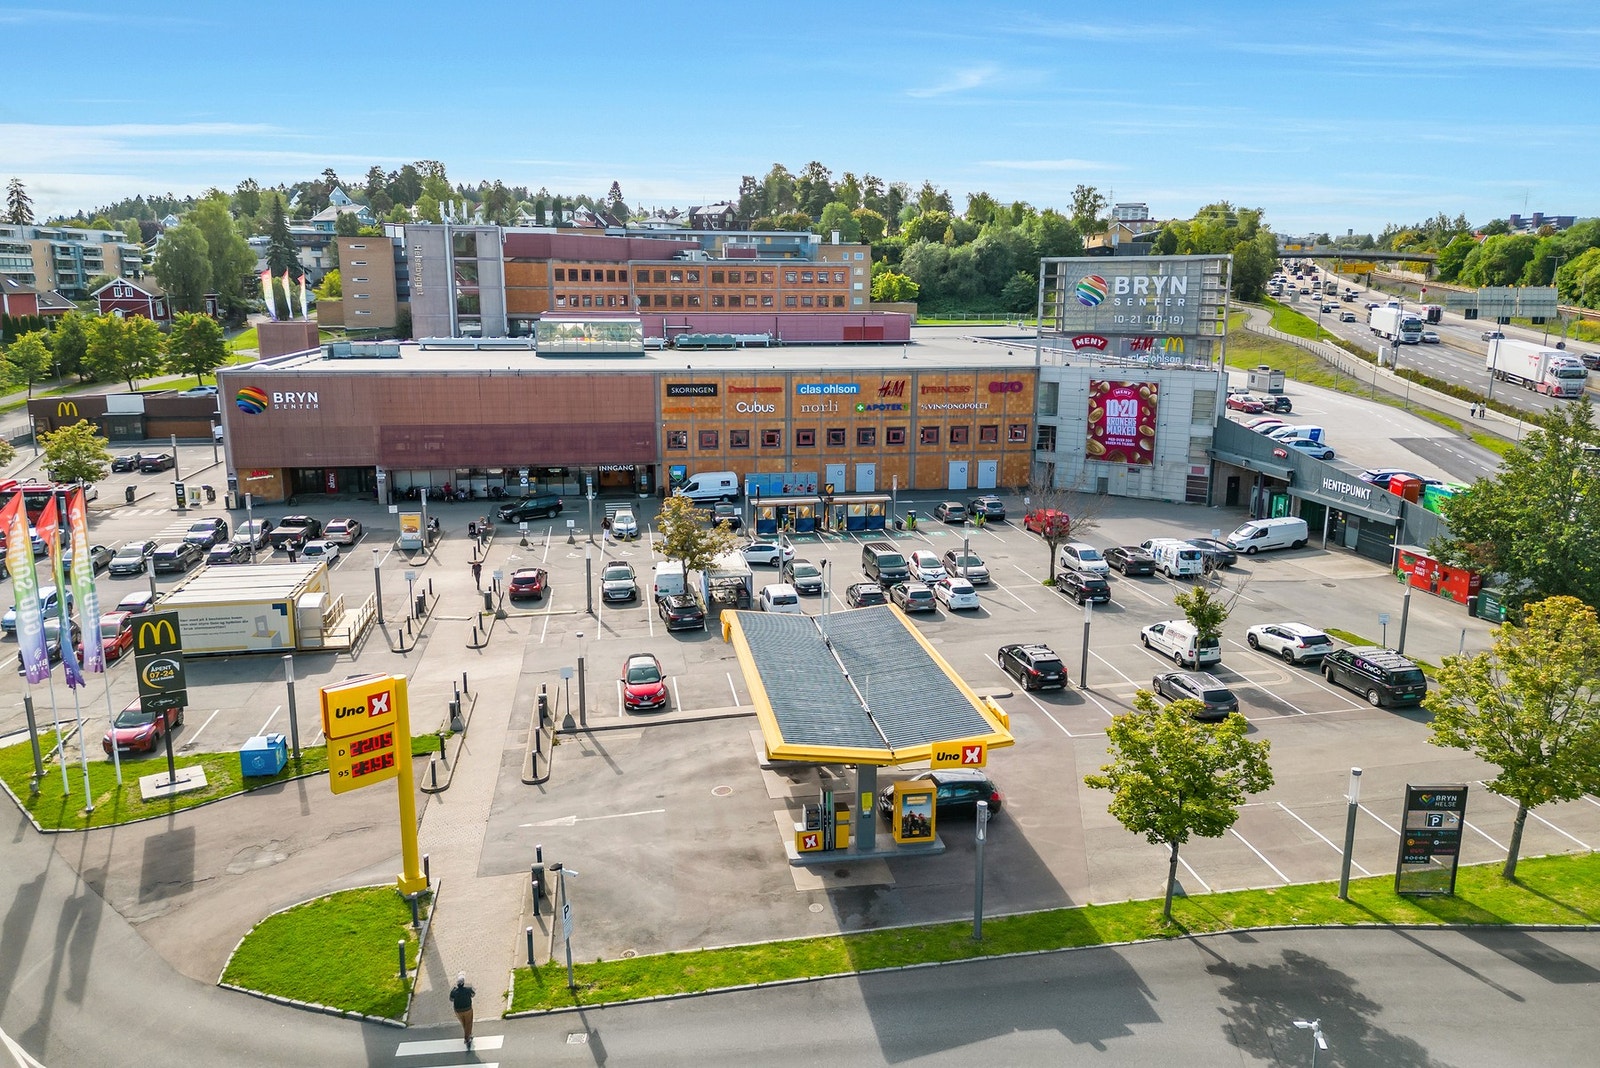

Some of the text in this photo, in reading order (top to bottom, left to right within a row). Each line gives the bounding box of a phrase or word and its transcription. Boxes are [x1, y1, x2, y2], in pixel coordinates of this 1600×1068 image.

[1115, 276, 1187, 295] BRYN
[1114, 298, 1186, 306] SENTER
[1114, 315, 1184, 325] 10-21 (10-19)
[1076, 337, 1104, 347] MENY
[1150, 353, 1181, 363] ohlson
[671, 386, 714, 394] SKORINGEN
[800, 384, 857, 394] clas ohlson
[273, 392, 318, 403] BRYN
[736, 401, 775, 413] Cubus
[801, 400, 838, 412] norli
[866, 403, 902, 411] APOTEK
[928, 402, 988, 410] VINMONOPOLET
[1106, 426, 1136, 436] MARKED
[598, 464, 634, 472] INNGANG
[1322, 478, 1371, 500] HENTEPUNKT
[1363, 662, 1381, 675] OneCo
[149, 669, 174, 679] 07-24
[335, 692, 389, 718] Uno X
[338, 732, 393, 757] D 22.05
[936, 747, 980, 763] Uno X
[352, 752, 394, 778] 23.95
[1431, 817, 1439, 826] P
[564, 904, 569, 919] P
